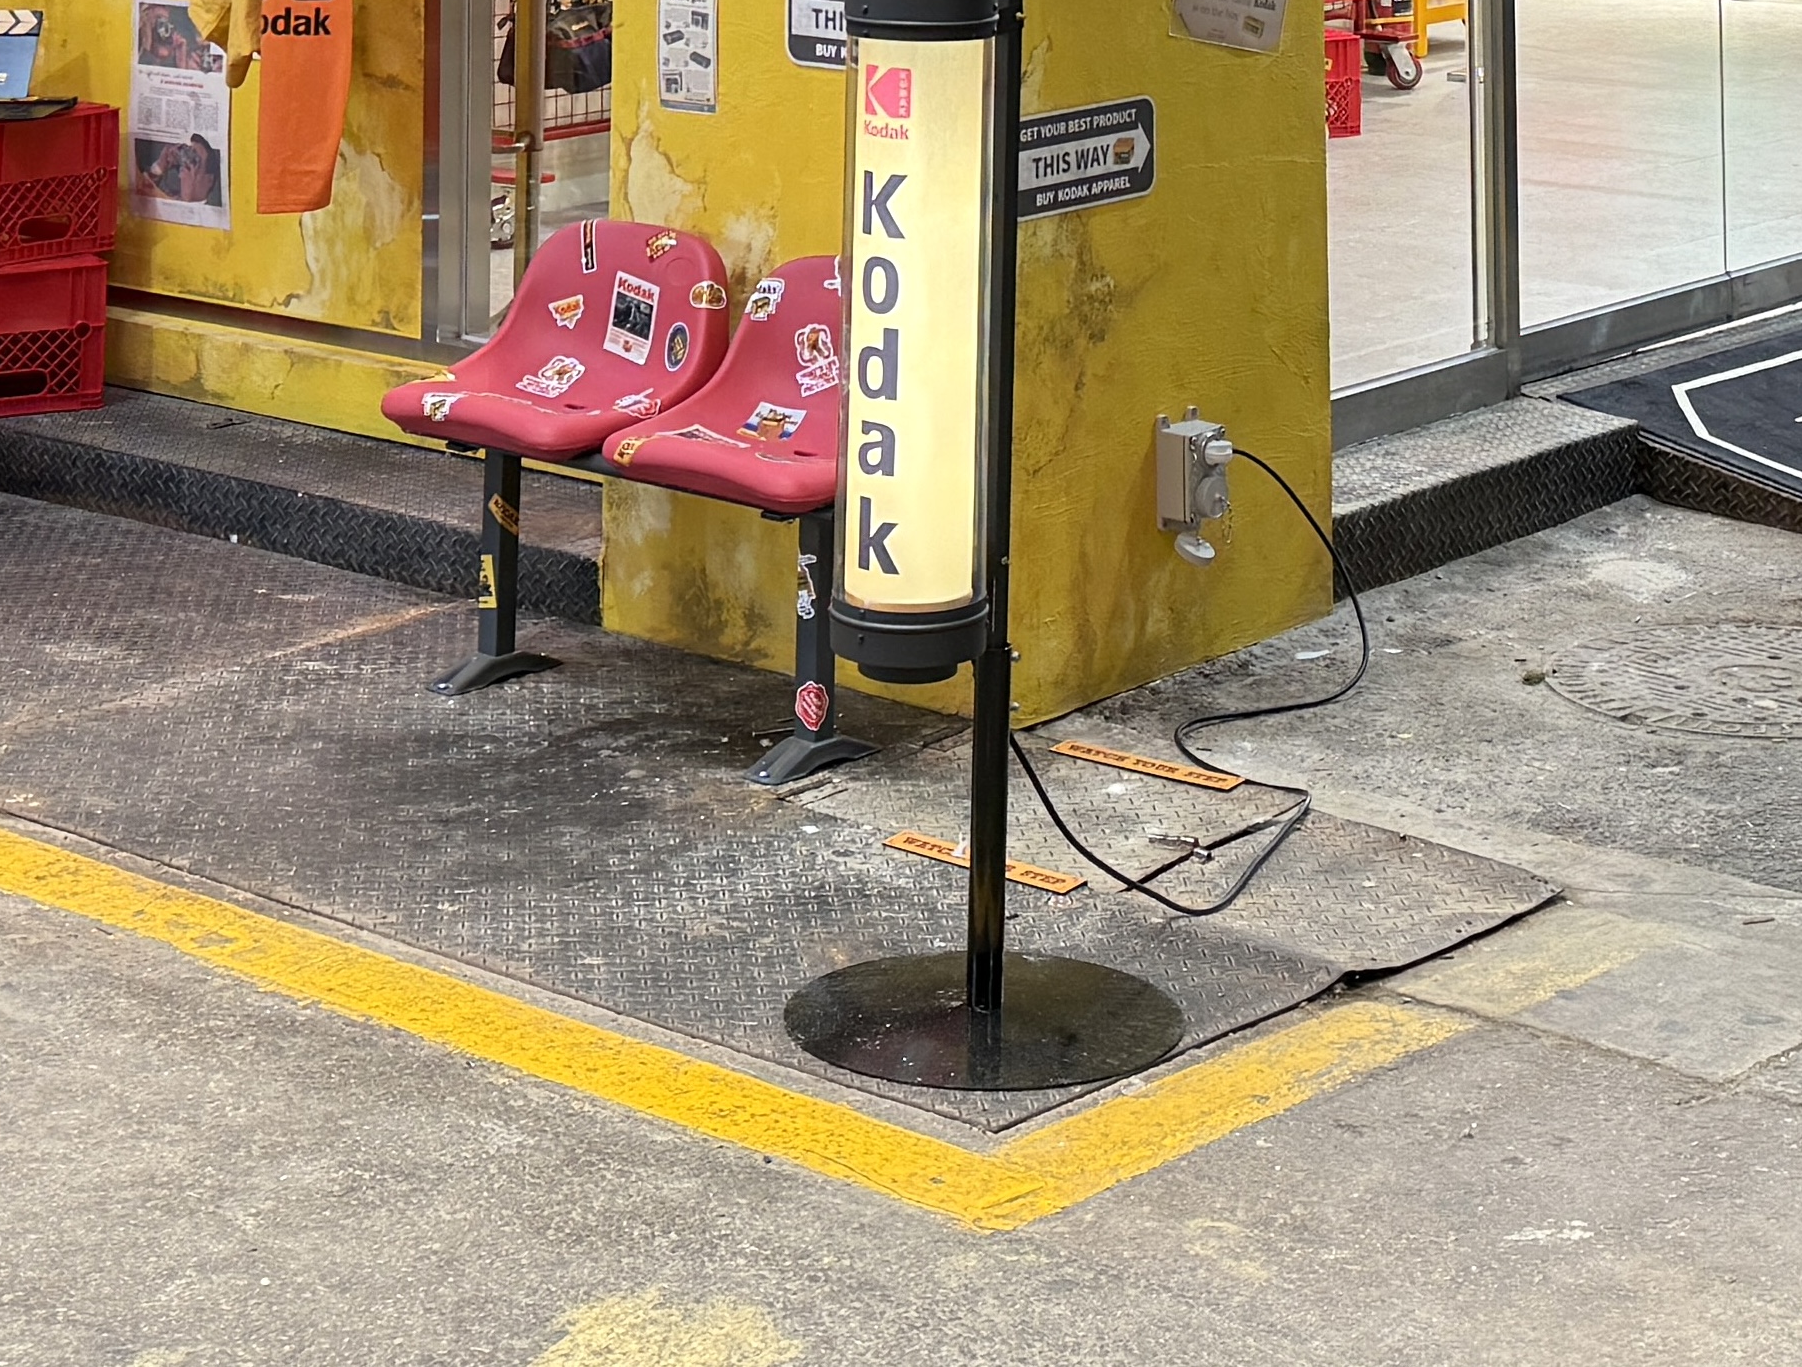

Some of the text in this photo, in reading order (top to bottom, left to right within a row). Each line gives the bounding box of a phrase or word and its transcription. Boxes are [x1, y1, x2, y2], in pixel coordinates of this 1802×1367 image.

[260, 7, 332, 37] dak
[811, 8, 846, 32] THI
[815, 43, 838, 58] BUY
[863, 120, 910, 141] Kodak
[1019, 108, 1137, 142] GET YOUR BEST PRODUCT
[1032, 143, 1111, 180] THIS WAY
[1036, 176, 1131, 207] BUY KODAK APPAREL
[617, 275, 657, 304] Kodak
[858, 169, 909, 576] Kodak
[1067, 742, 1229, 785] WATCH YOUR STEP
[902, 835, 957, 857] WATC
[1019, 869, 1067, 887] STEP
